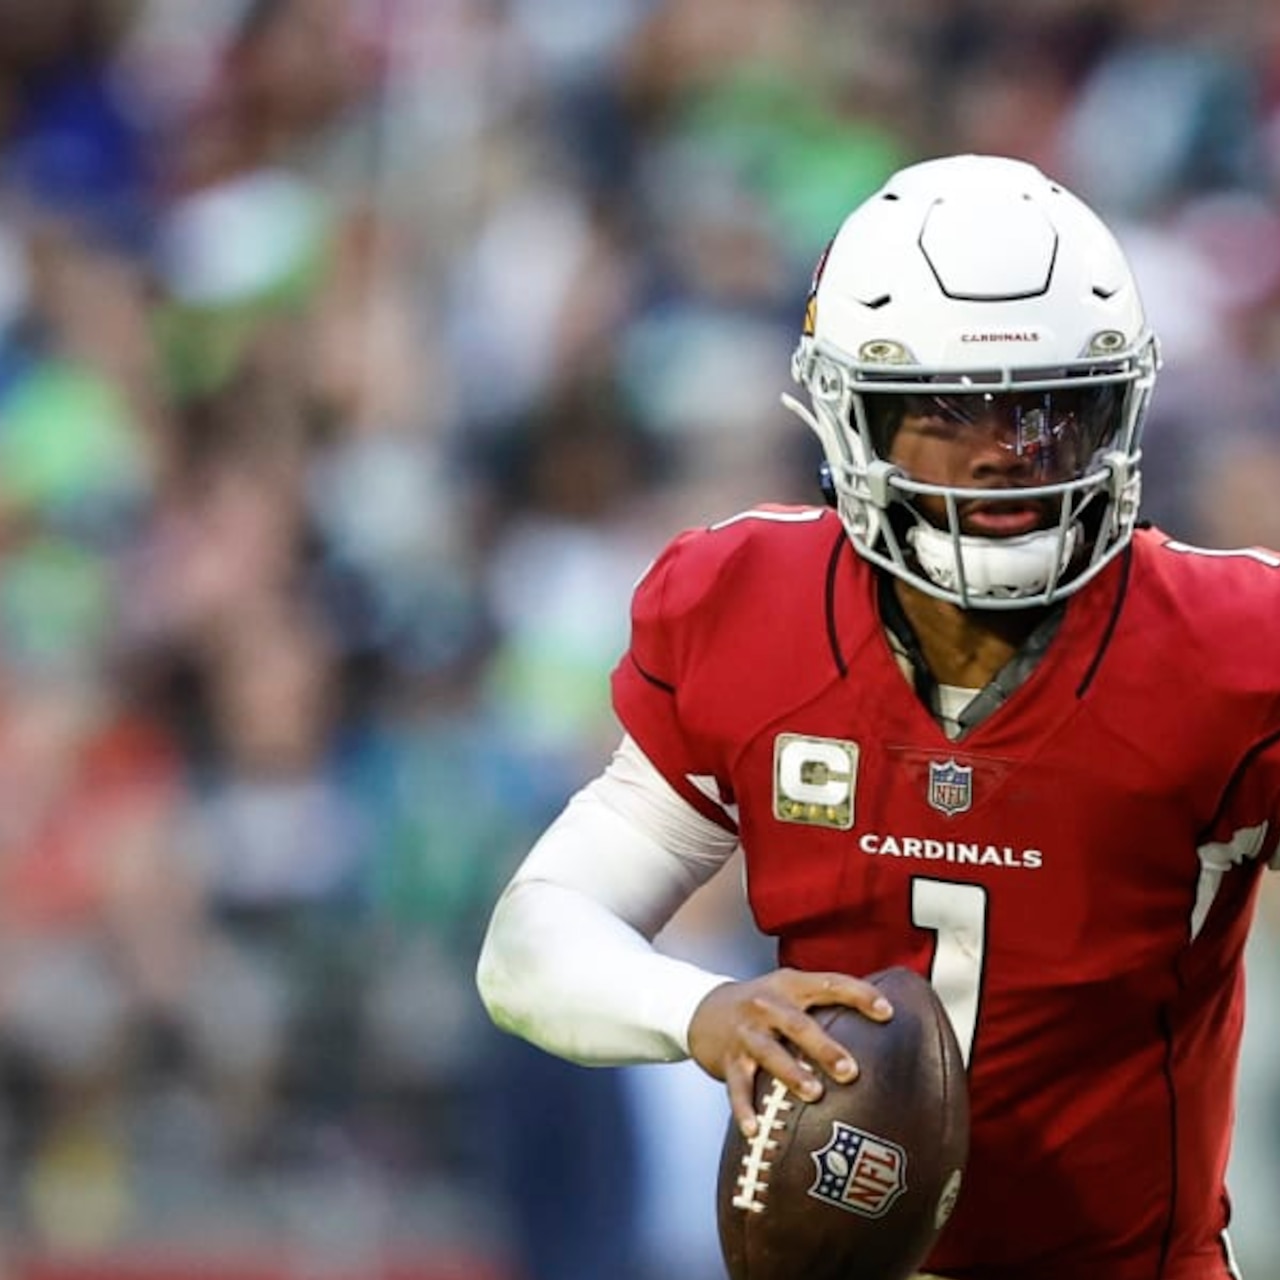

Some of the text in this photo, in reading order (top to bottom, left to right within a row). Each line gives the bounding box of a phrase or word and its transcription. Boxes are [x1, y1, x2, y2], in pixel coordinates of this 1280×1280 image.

[960, 331, 1040, 343] CARDINALS
[779, 739, 852, 806] C
[859, 834, 1043, 869] CARDINALS
[912, 877, 986, 1074] 1
[846, 1147, 899, 1209] NFL
